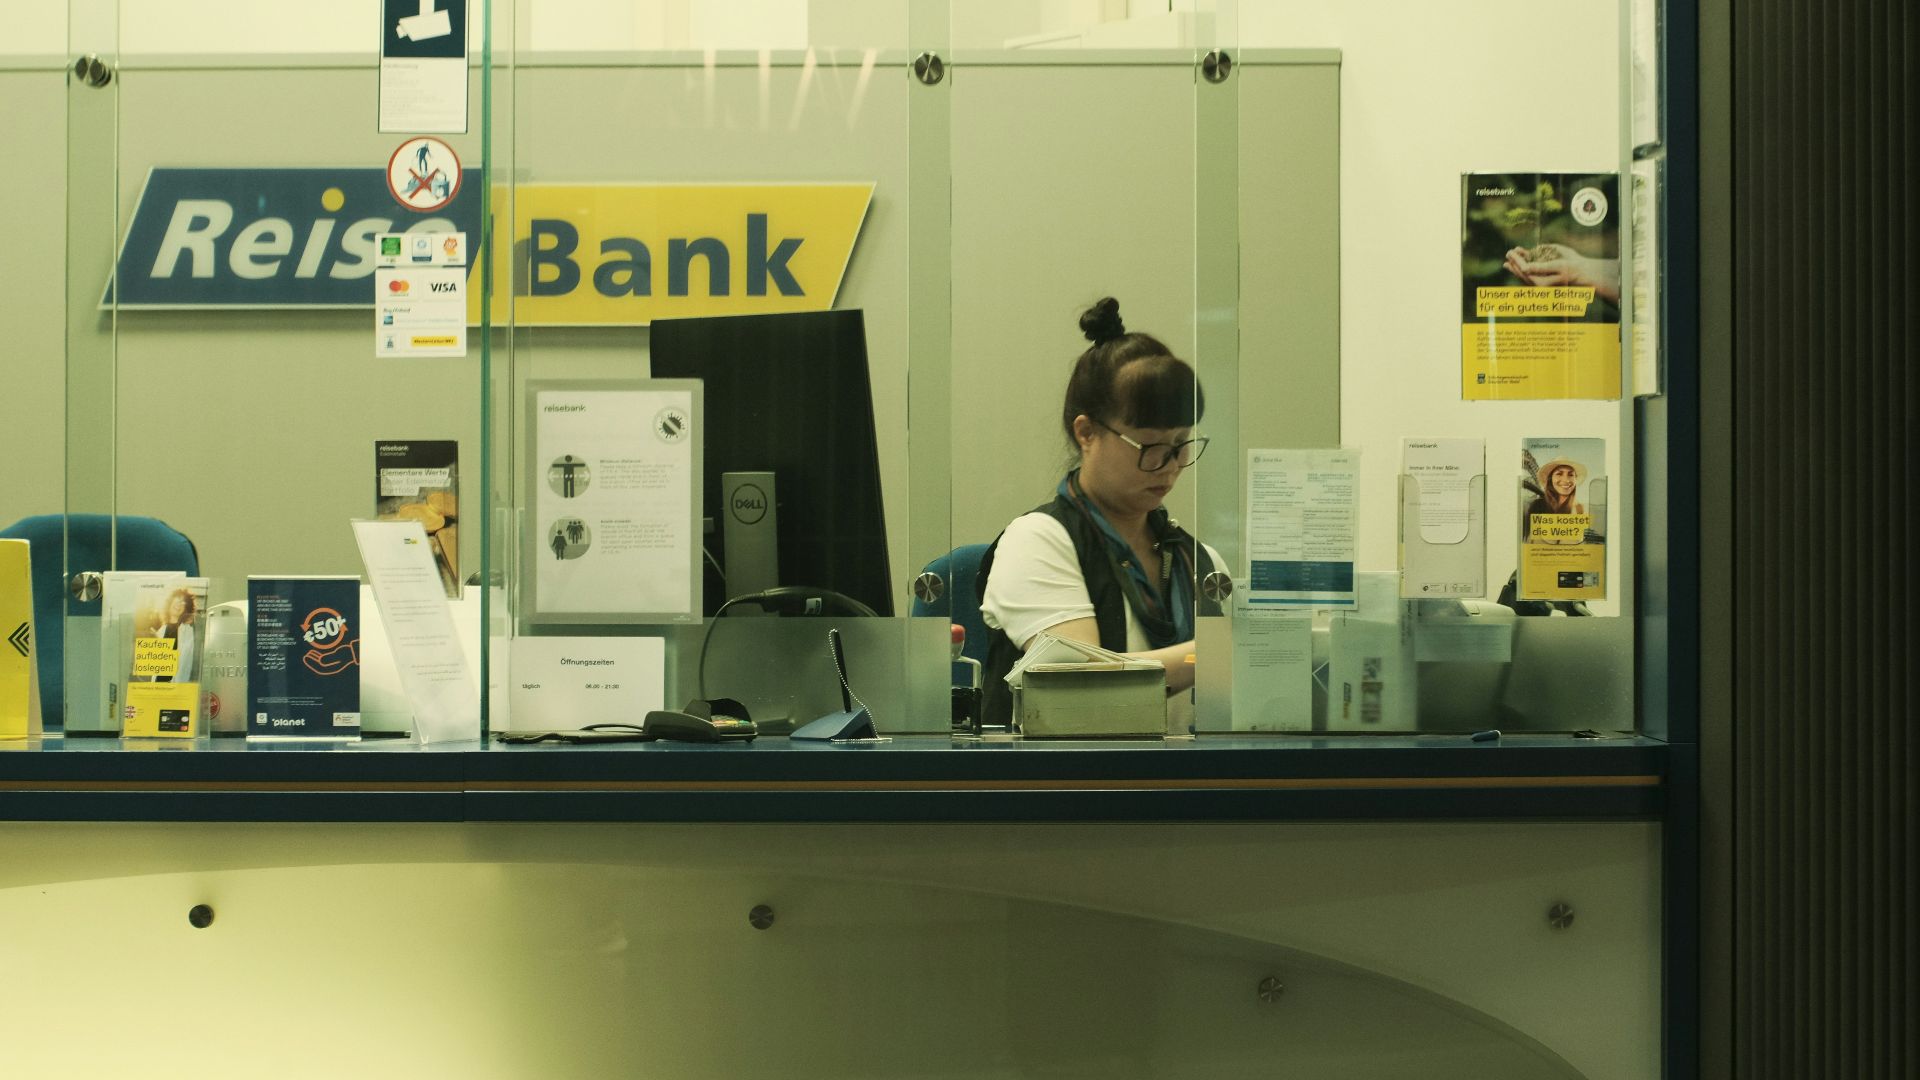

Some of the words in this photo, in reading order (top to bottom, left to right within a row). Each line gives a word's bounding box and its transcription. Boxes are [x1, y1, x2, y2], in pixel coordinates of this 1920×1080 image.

[1476, 186, 1515, 196] reisebank
[150, 187, 456, 280] Reis
[520, 213, 806, 297] Bank
[431, 283, 457, 293] VISA
[1479, 289, 1509, 299] Unser
[1513, 288, 1550, 299] aktiver
[1553, 288, 1592, 301] Beitrag
[1479, 302, 1495, 312] für
[1498, 303, 1515, 312] ein
[1517, 304, 1549, 314] gutes
[1552, 302, 1584, 312] Klima.
[544, 404, 586, 412] reisebank
[381, 469, 423, 477] Elementare
[425, 468, 448, 476] Werte
[735, 500, 764, 509] DELL
[1532, 515, 1554, 525] Was
[1556, 515, 1590, 525] kostet
[1532, 527, 1548, 536] die
[1550, 527, 1580, 536] Welt?
[137, 640, 171, 650] Kaufen,
[136, 651, 177, 662] aufladen,
[560, 658, 615, 667] Öffnungszeiten
[135, 664, 174, 674] loslegen!
[272, 718, 305, 727] planet
